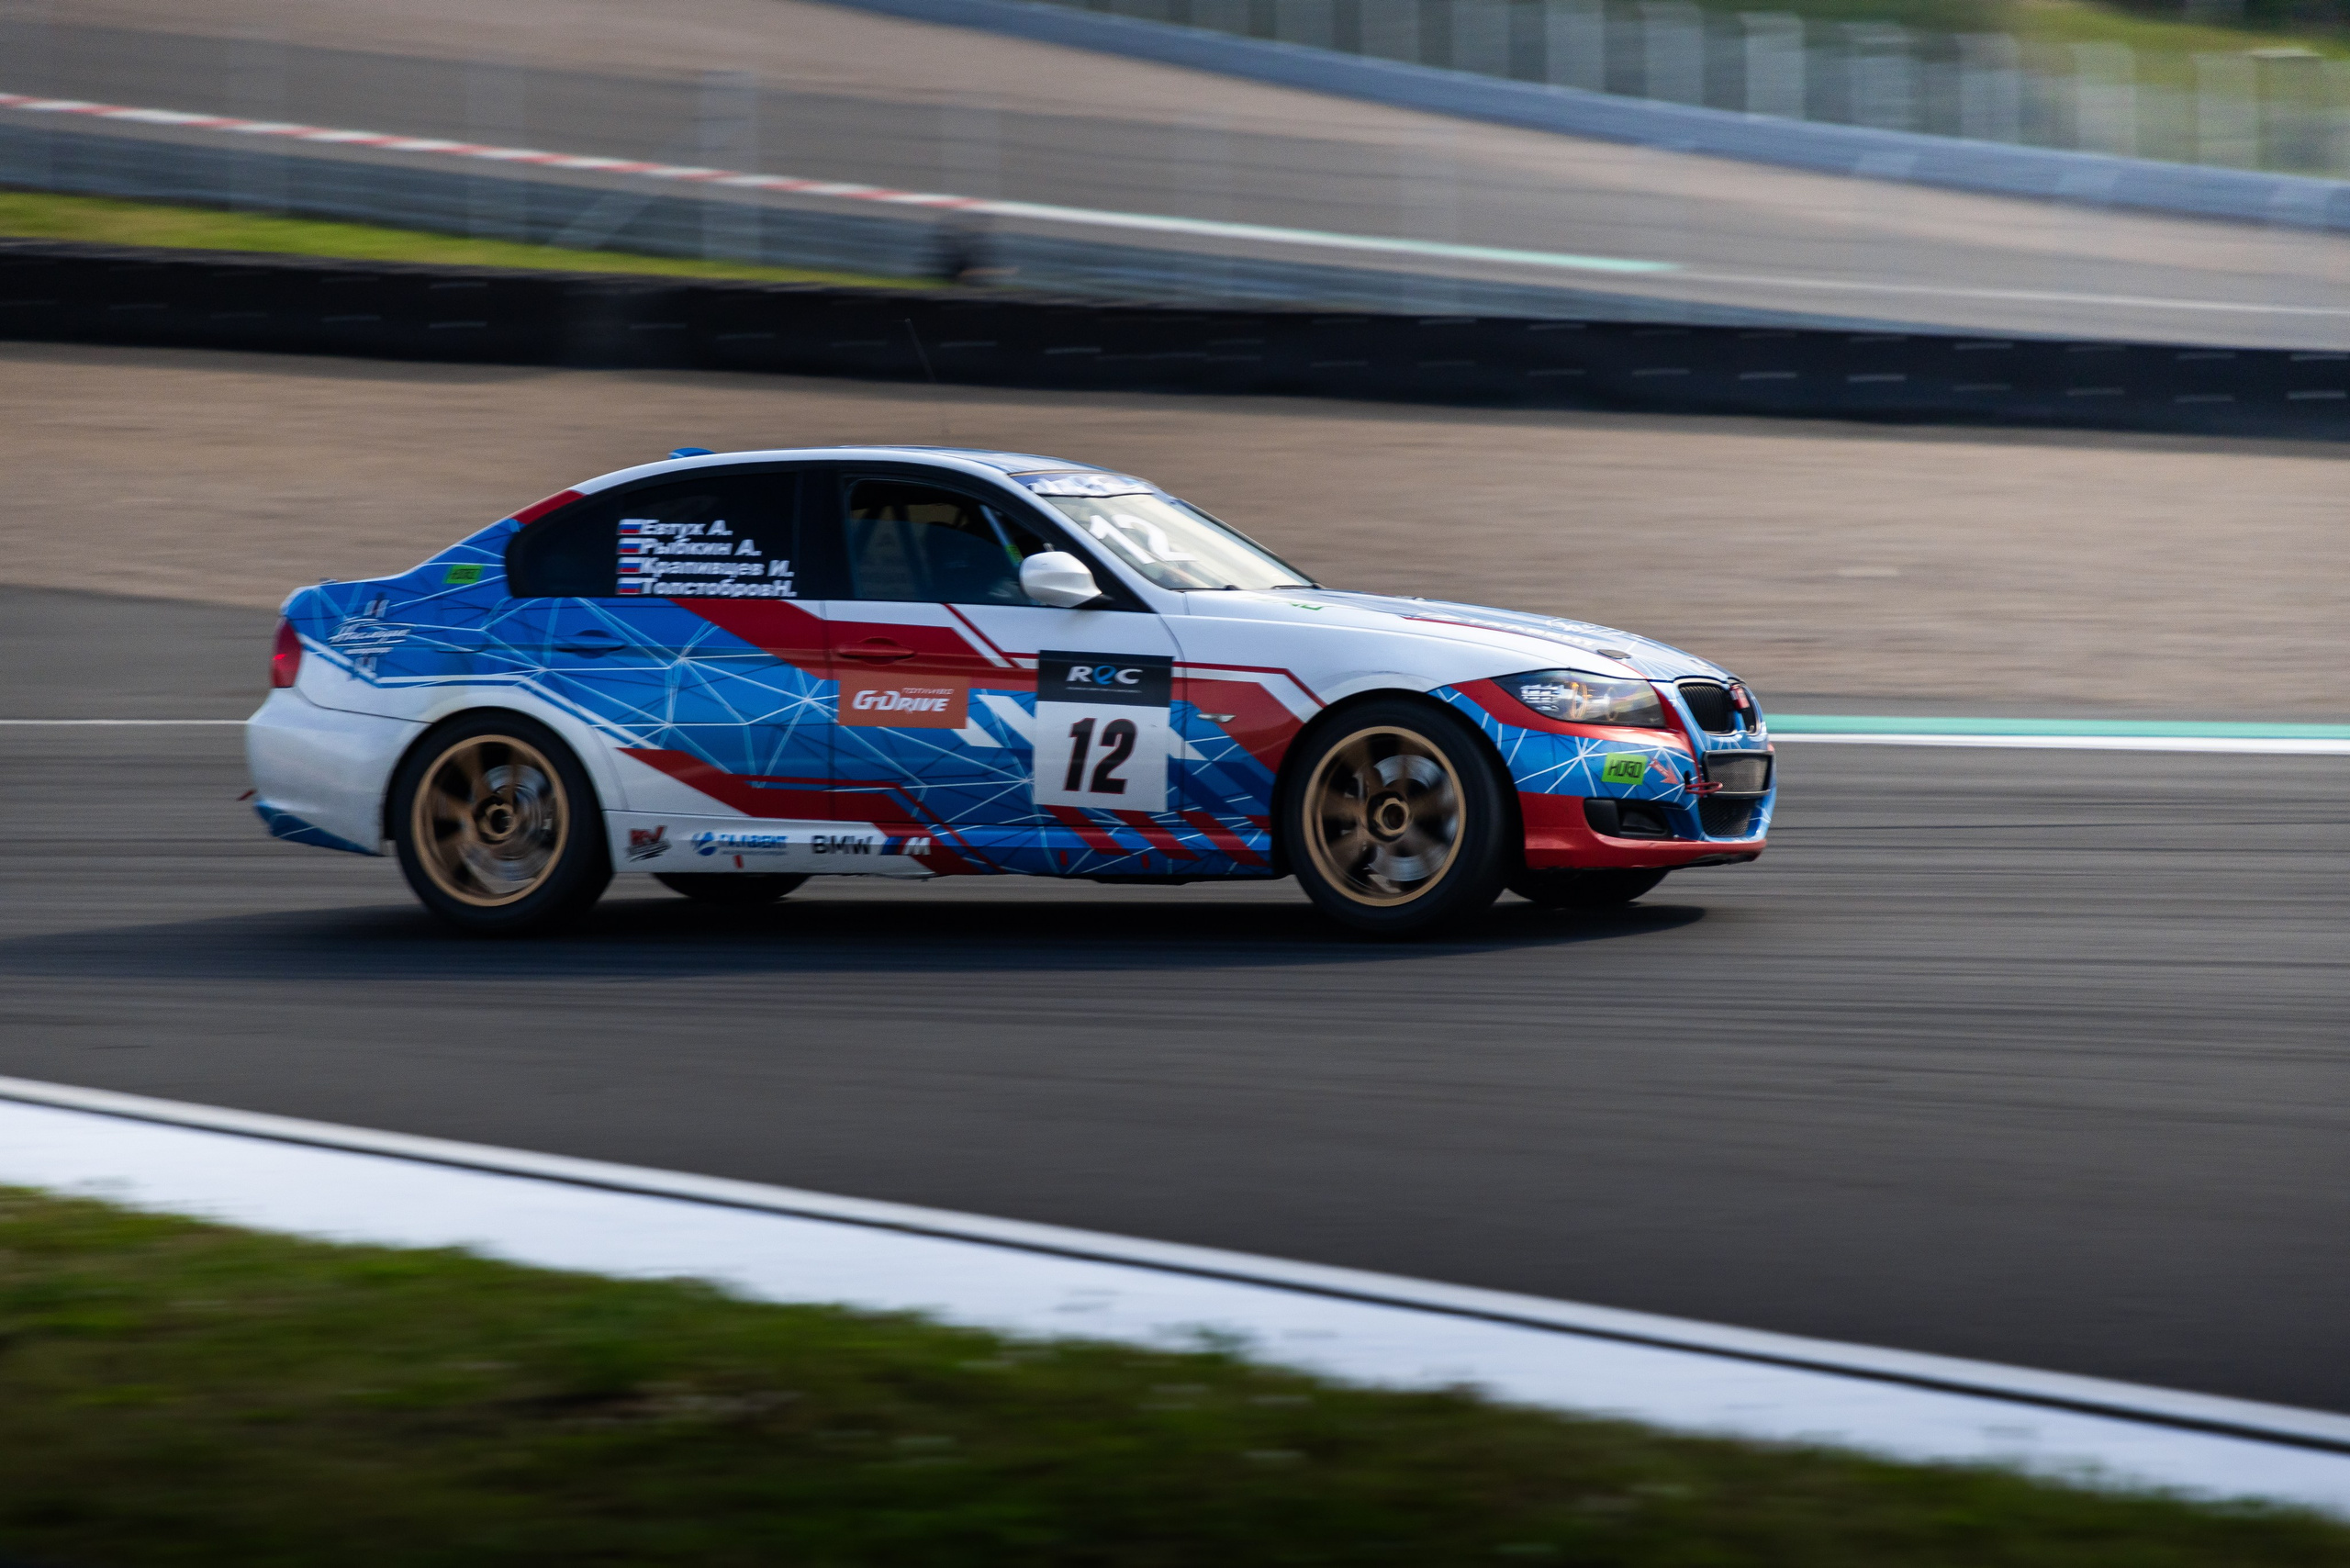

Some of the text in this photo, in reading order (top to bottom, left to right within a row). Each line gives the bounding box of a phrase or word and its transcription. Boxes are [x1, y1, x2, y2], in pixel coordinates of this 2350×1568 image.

[643, 519, 733, 540] Евтух А.
[1090, 514, 1198, 565] 12
[642, 538, 762, 556] Рыбкин А.
[767, 560, 795, 577] И.
[1063, 717, 1138, 794] 12
[811, 835, 873, 855] BMW
